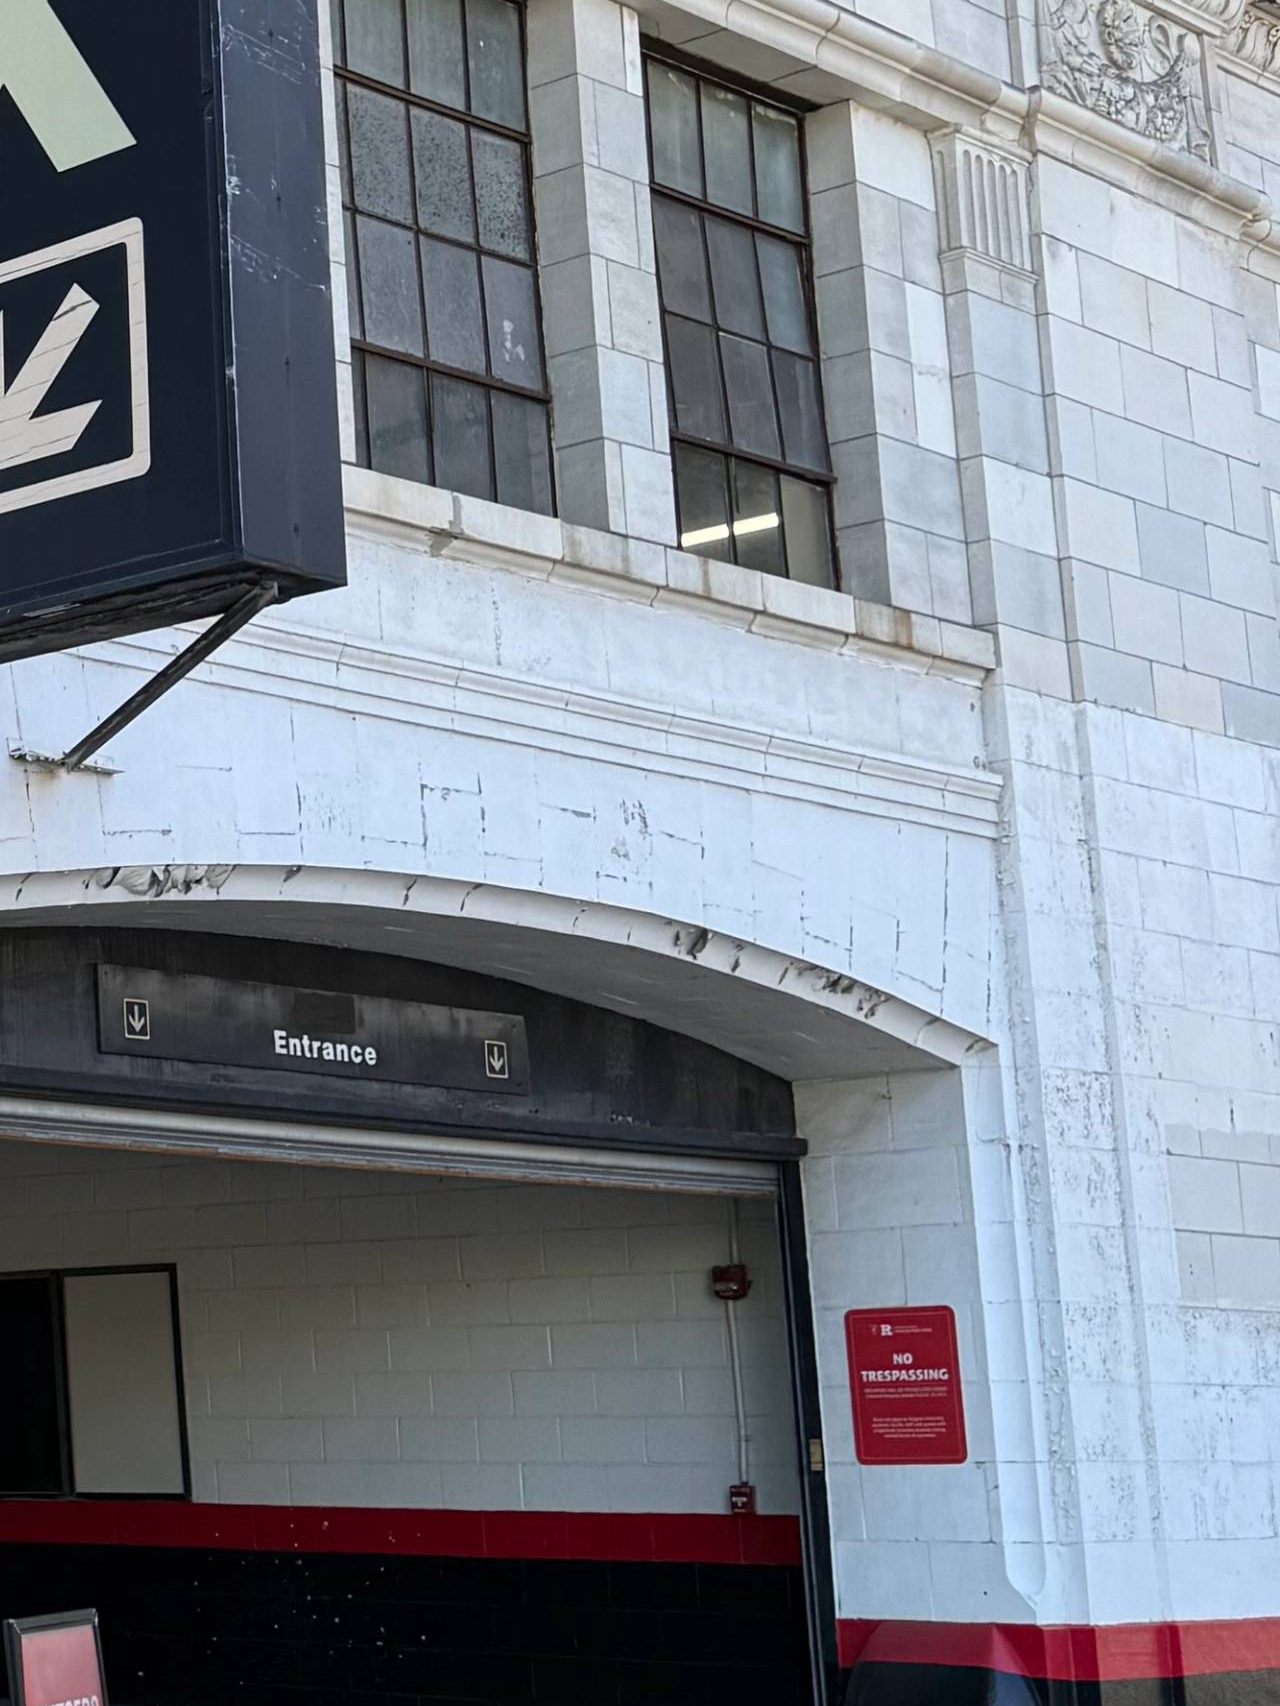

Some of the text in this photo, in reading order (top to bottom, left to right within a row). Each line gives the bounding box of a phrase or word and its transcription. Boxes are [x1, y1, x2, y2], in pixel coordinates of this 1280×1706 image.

[273, 1029, 378, 1067] Entrance
[880, 1324, 893, 1337] R
[892, 1353, 913, 1365] NO
[860, 1368, 949, 1382] TRESPASSING
